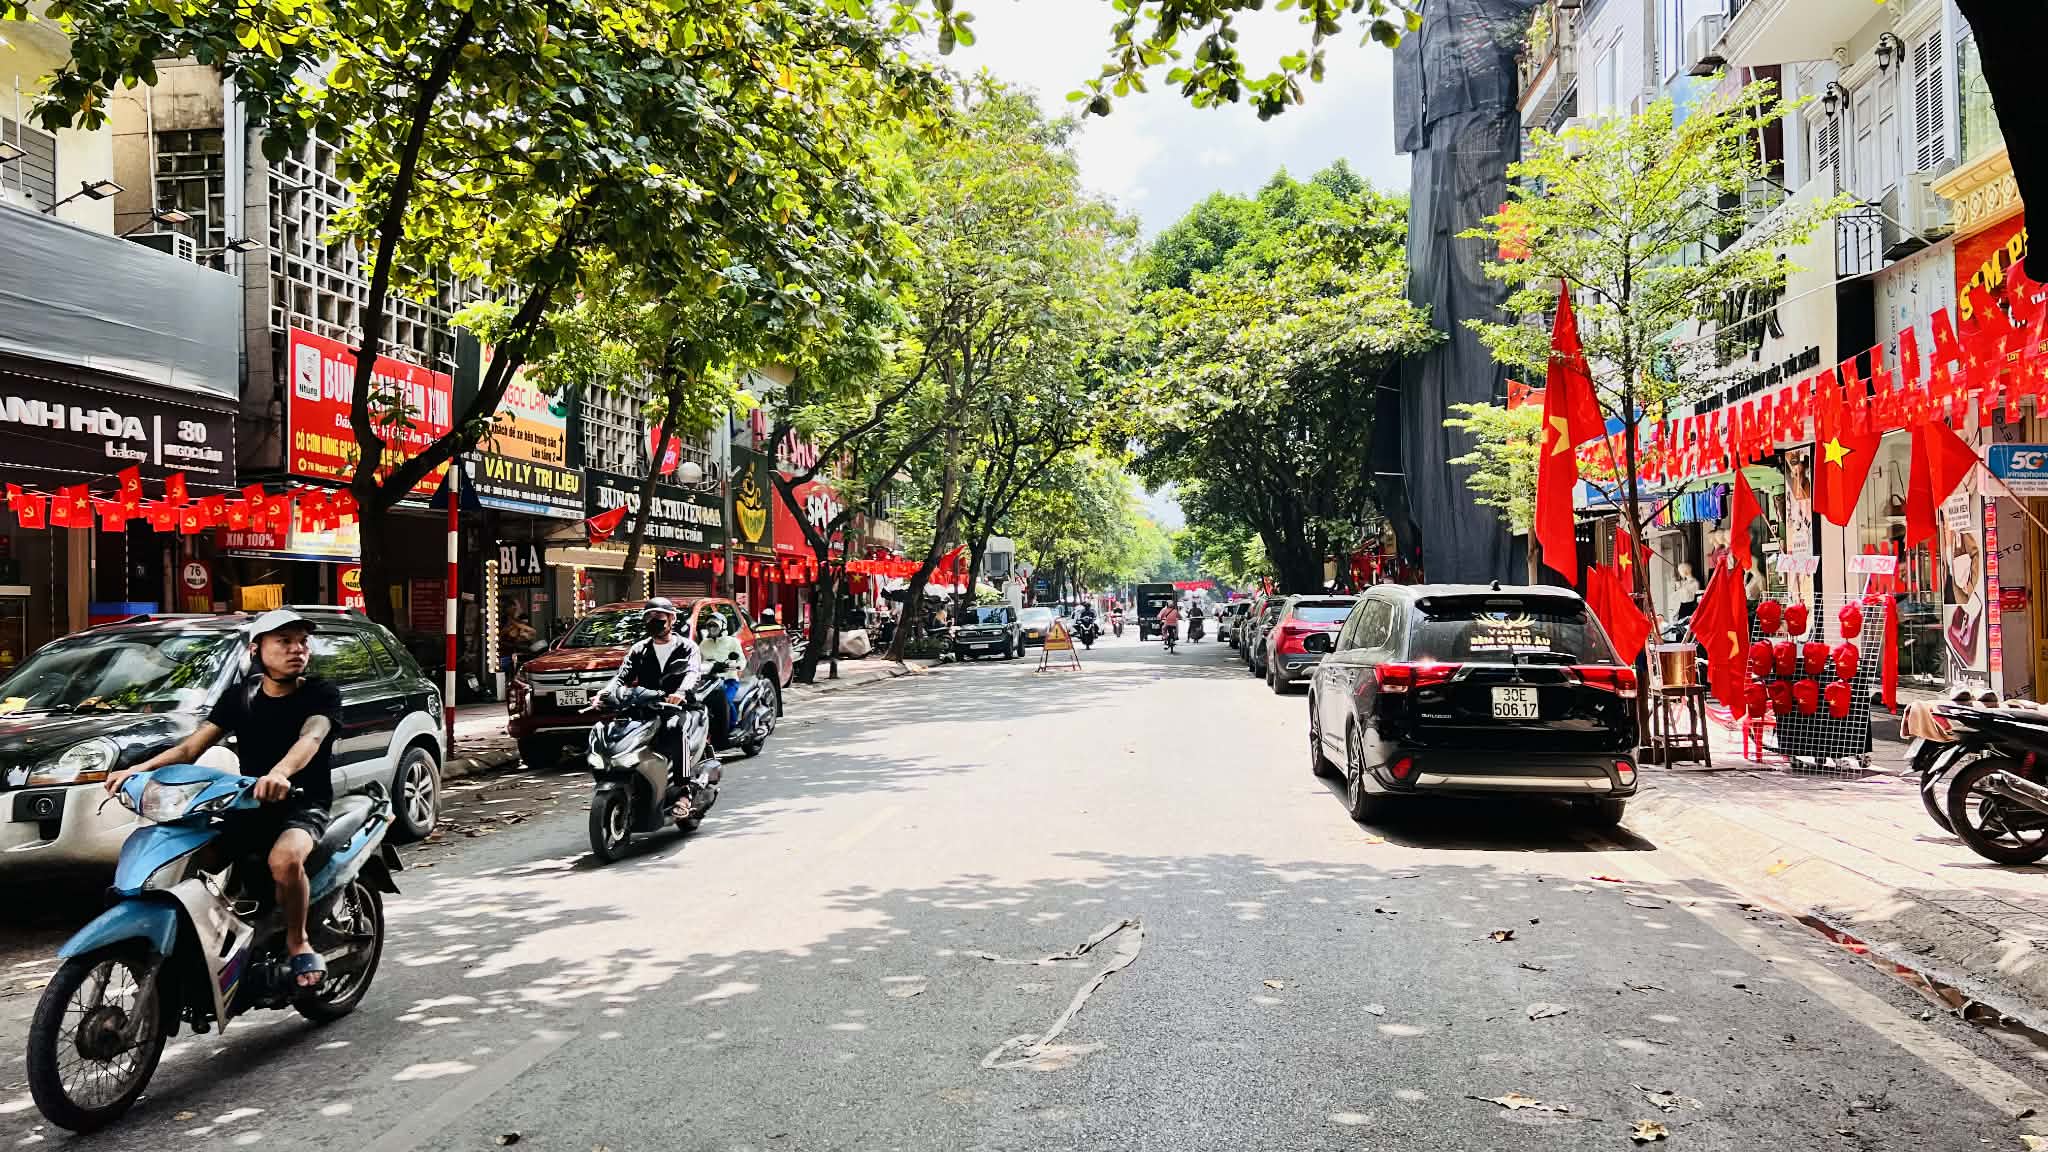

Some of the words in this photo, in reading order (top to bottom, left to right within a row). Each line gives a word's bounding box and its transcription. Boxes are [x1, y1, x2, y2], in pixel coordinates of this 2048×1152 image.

[70, 407, 146, 440] HÒA
[484, 456, 513, 483] VẬT
[515, 462, 531, 485] LÝ
[534, 467, 552, 492] TRỊ
[247, 533, 275, 546] 100%
[190, 565, 201, 576] 76
[345, 593, 366, 609] BÚ
[1503, 688, 1528, 702] 30E
[1494, 702, 1537, 717] 506.17
